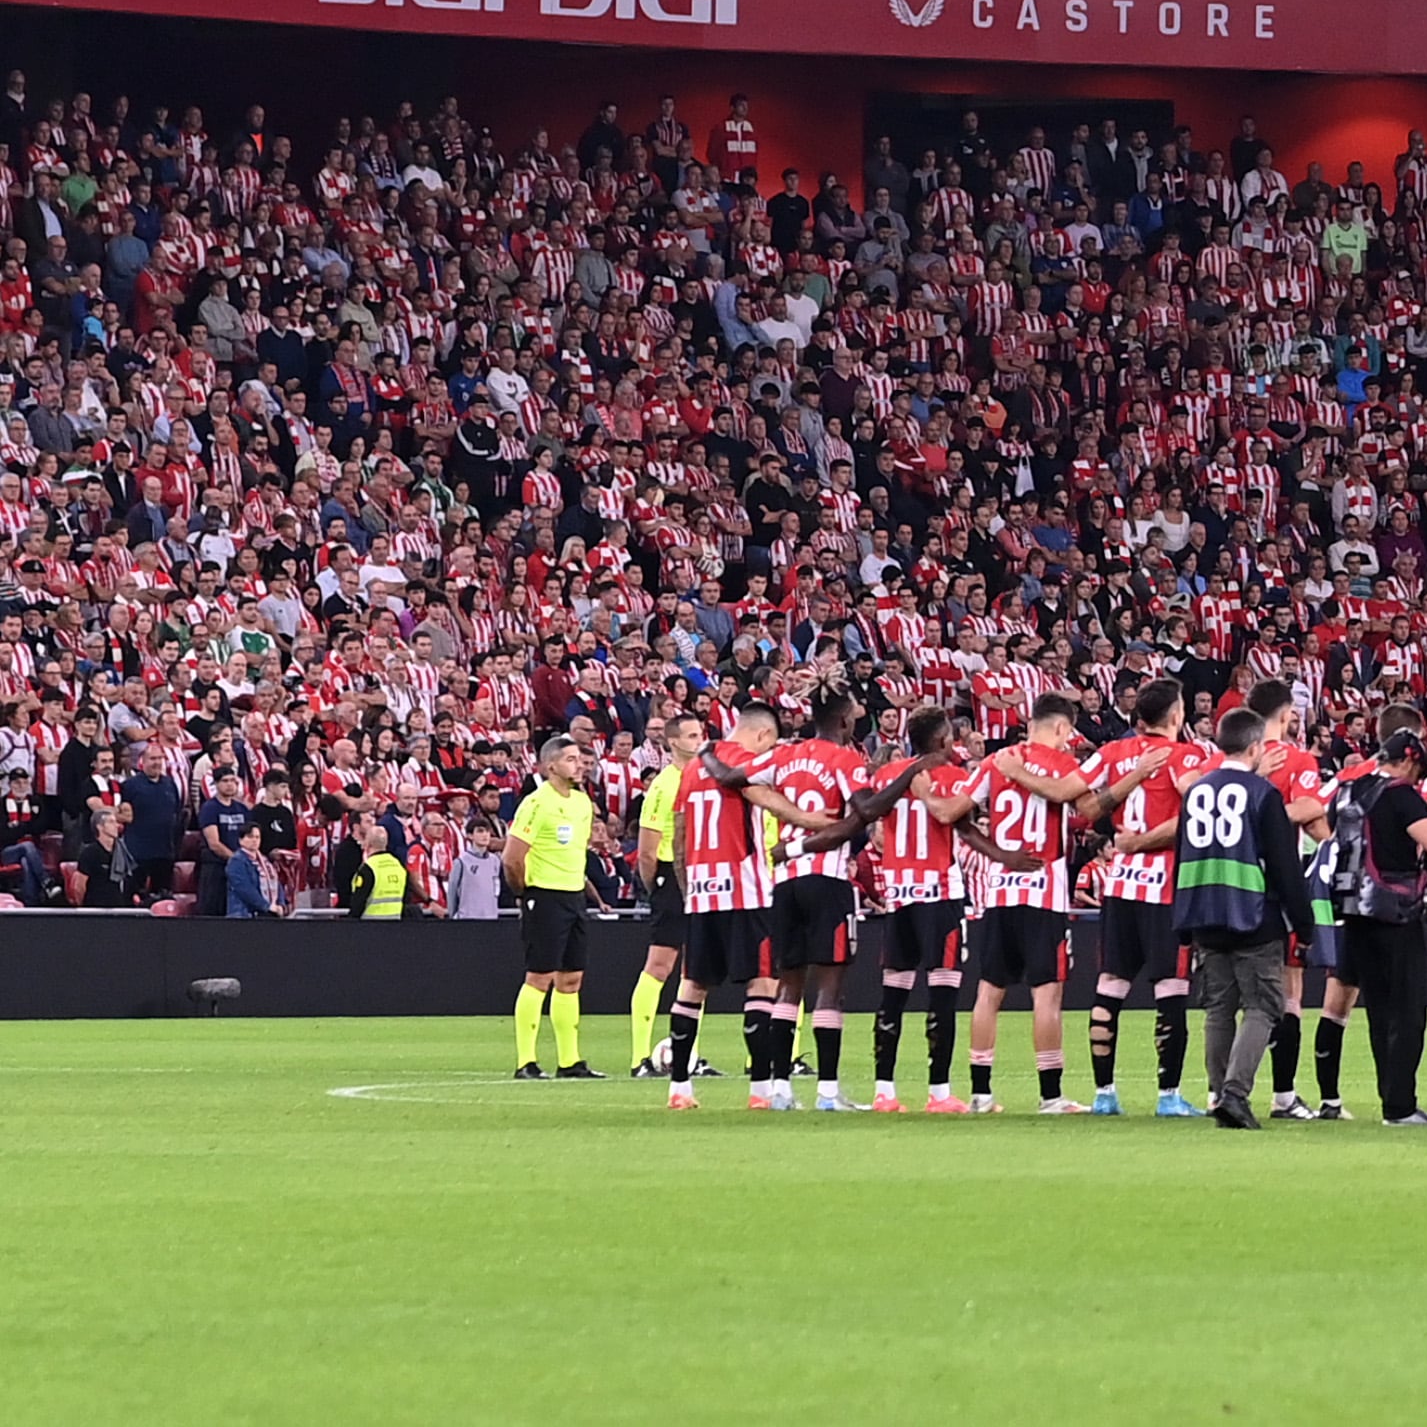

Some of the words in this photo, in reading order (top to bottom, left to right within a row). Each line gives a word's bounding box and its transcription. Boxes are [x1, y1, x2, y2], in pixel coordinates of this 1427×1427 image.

[687, 789, 722, 851] 17
[893, 797, 928, 860] 11
[994, 789, 1048, 852] 24
[1186, 783, 1248, 848] 88
[886, 885, 939, 899] DIGI
[990, 875, 1046, 890] DIGI
[1108, 866, 1165, 884] DIGI
